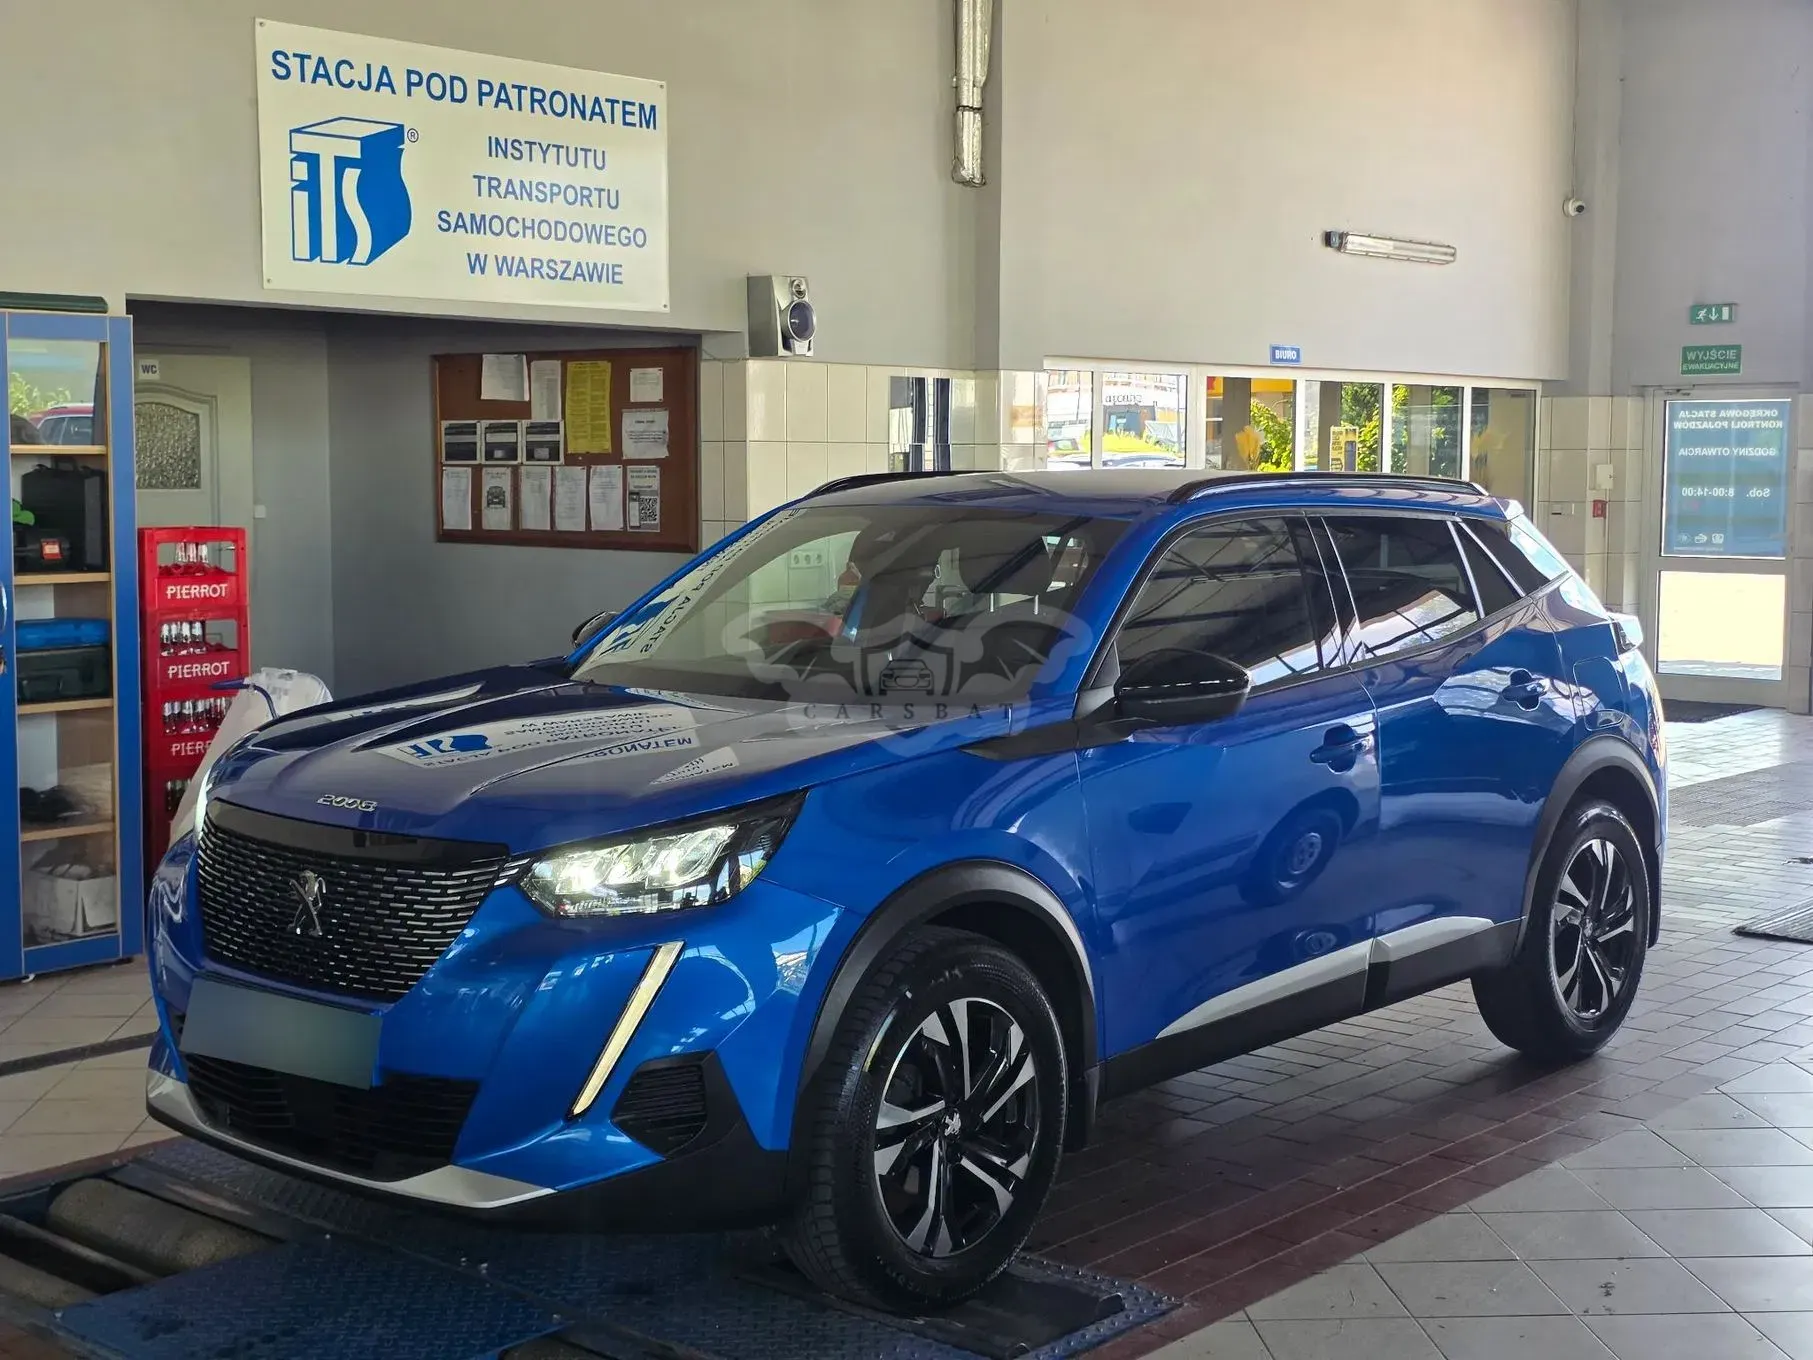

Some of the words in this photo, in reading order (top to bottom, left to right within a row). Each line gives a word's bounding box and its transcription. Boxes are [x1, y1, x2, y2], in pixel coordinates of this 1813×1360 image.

[271, 50, 397, 95] STACJA
[406, 69, 468, 104] POD
[477, 79, 658, 131] PATRONATEM
[487, 136, 607, 171] INSTYTUTU
[473, 175, 620, 211] TRANSPORTU
[437, 211, 648, 249] SAMOCHODOWEGO
[467, 253, 489, 276] W
[495, 254, 624, 285] WARSZAWIE
[1275, 349, 1297, 360] BIURO
[1686, 348, 1737, 361] WYJŚCIE
[141, 363, 157, 375] WC
[166, 584, 229, 599] PIERROT
[167, 661, 230, 678] PIERROT
[316, 794, 378, 812] 2008
